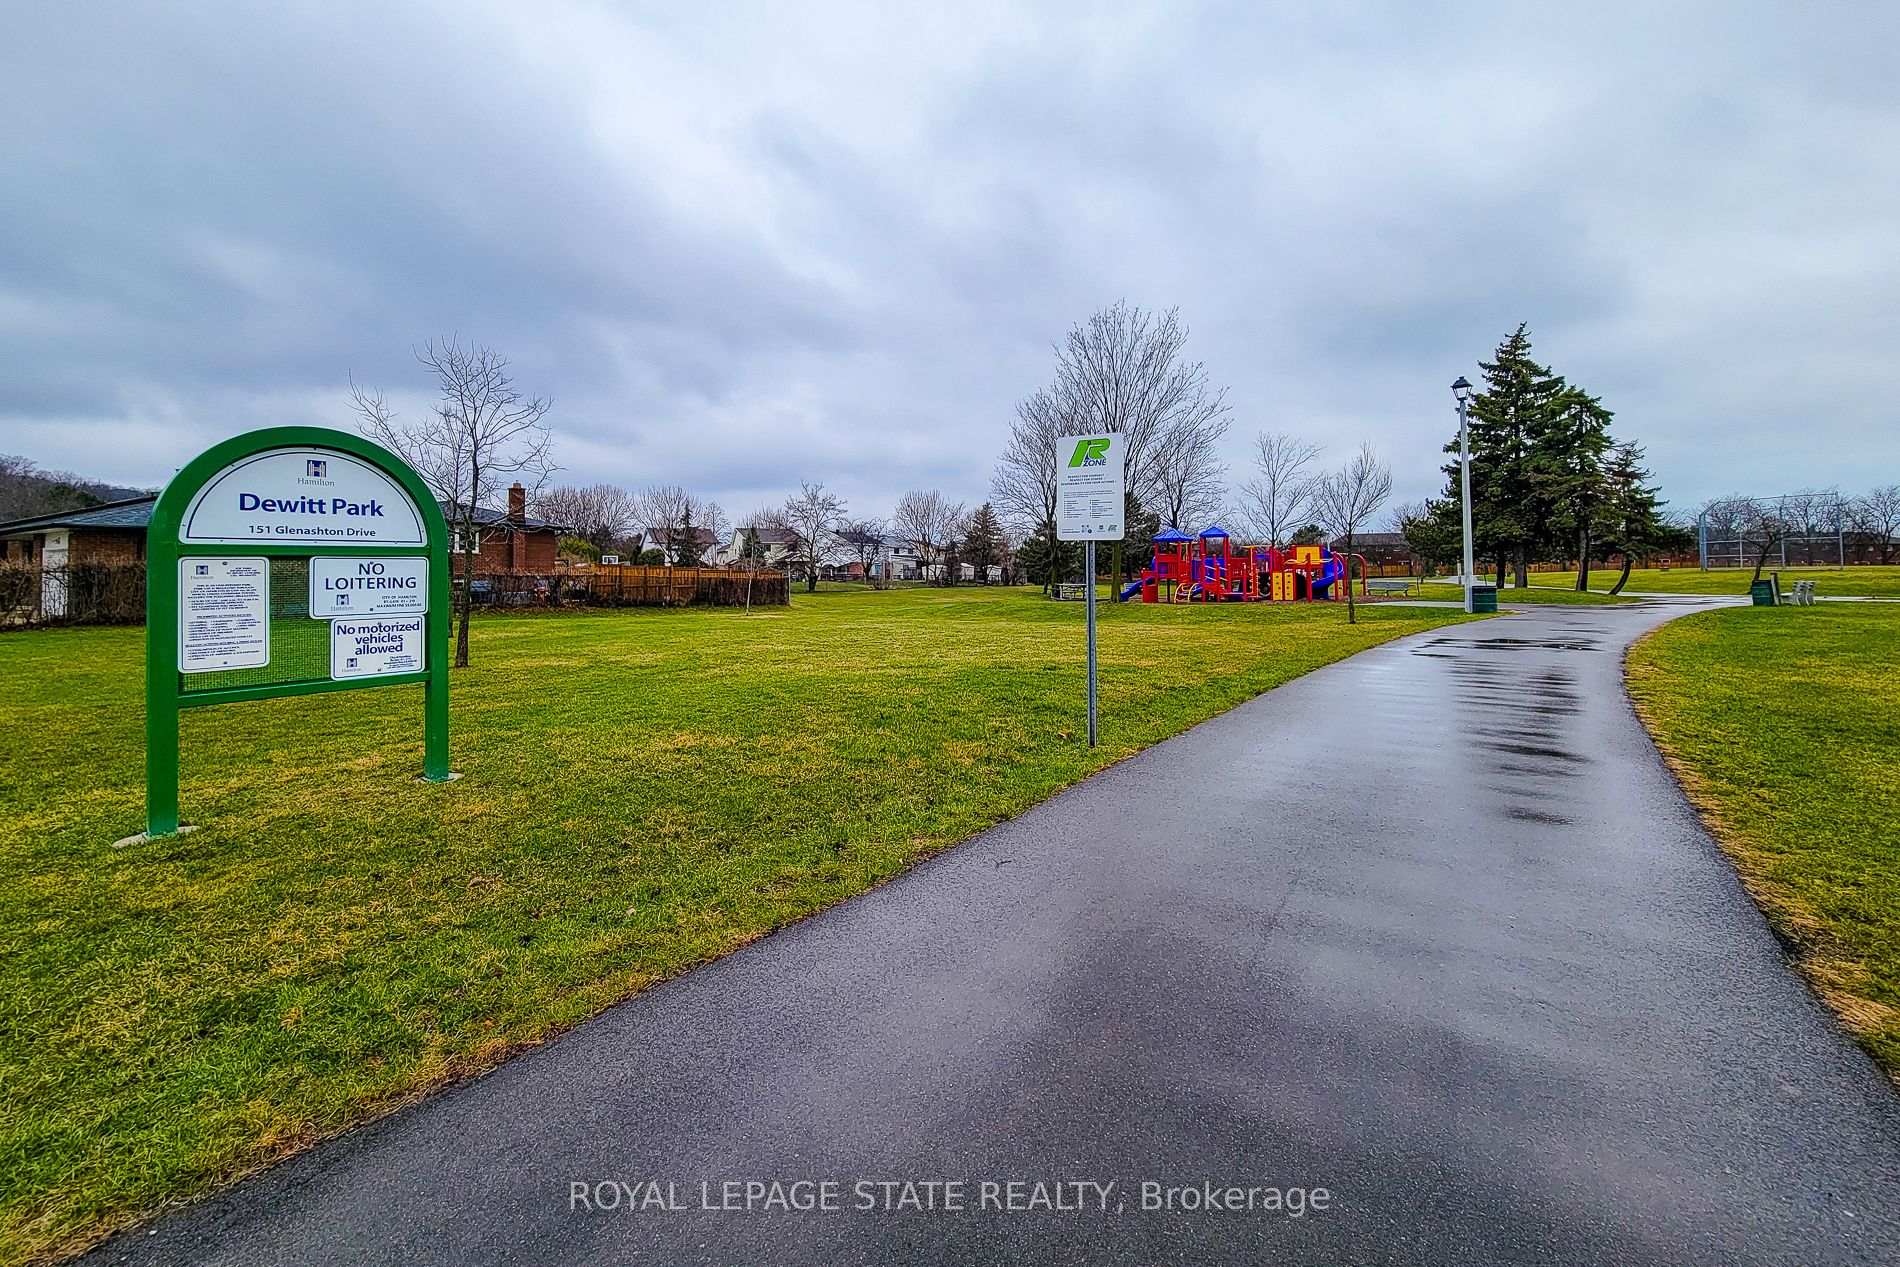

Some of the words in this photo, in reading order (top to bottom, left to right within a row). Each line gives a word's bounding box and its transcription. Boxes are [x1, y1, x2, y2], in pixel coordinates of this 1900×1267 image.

[1083, 458, 1106, 467] ZONE
[298, 477, 335, 487] Hamilton
[239, 493, 326, 514] Dewitt
[332, 498, 384, 517] Park
[249, 525, 271, 534] 151
[275, 525, 344, 536] Glenashton
[346, 527, 376, 537] Drive
[359, 563, 385, 575] NO
[325, 577, 417, 590] LOITERING
[337, 625, 355, 635] No
[358, 620, 420, 634] motorized
[355, 633, 403, 644] vehicles
[355, 642, 403, 655] allowed
